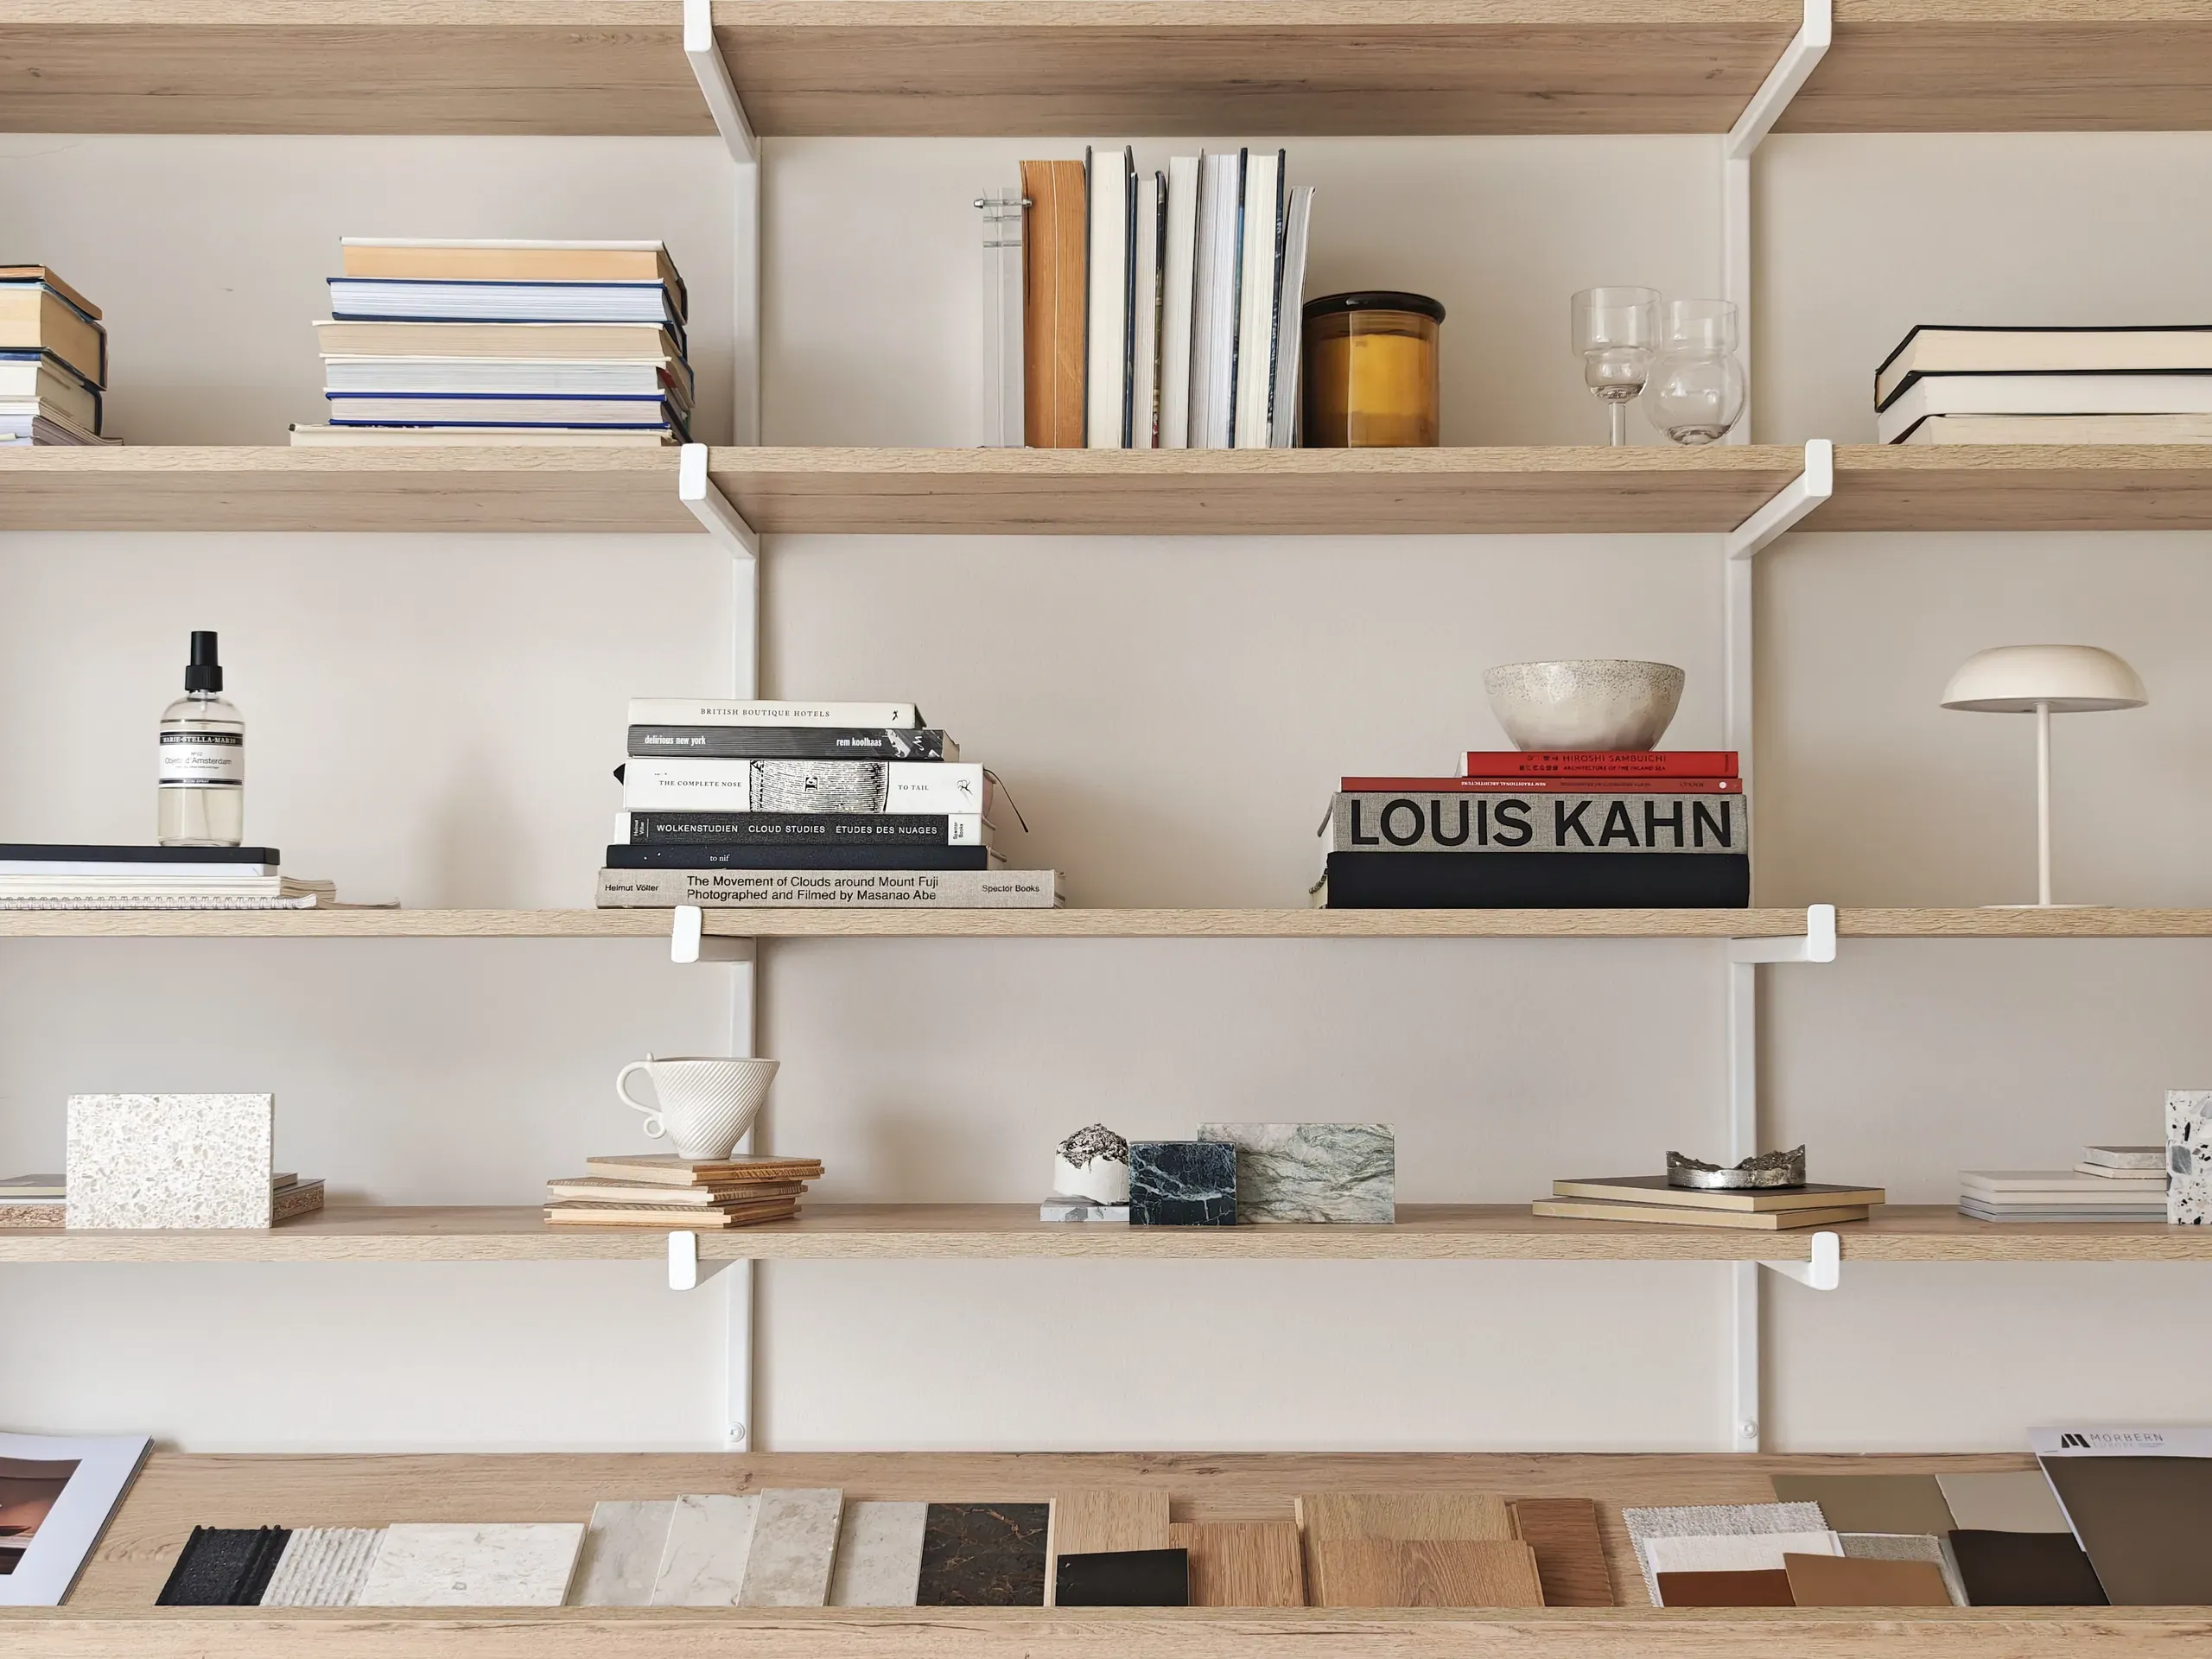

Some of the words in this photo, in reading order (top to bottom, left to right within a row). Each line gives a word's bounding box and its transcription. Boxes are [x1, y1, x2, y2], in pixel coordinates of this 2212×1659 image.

[645, 734, 674, 745] delirious
[690, 735, 706, 747] york
[852, 737, 882, 747] koolhaas
[1351, 798, 1533, 847] LOUIS
[1555, 800, 1732, 848] KAHN
[785, 825, 825, 834] STUDIES
[899, 826, 938, 835] NUAGES
[687, 876, 709, 887] The
[713, 876, 773, 887] Movement
[777, 876, 788, 887] of
[791, 876, 831, 887] Clouds
[834, 877, 874, 887] around
[879, 877, 915, 887] Mount
[918, 876, 939, 889] Fuji
[982, 884, 1013, 893] Spector
[1015, 884, 1040, 893] Books
[687, 889, 768, 902] Photographed
[772, 890, 793, 900] and
[798, 890, 836, 900] Filmed
[839, 890, 854, 903] by
[857, 890, 910, 900] Masanao
[912, 890, 937, 900] Abe
